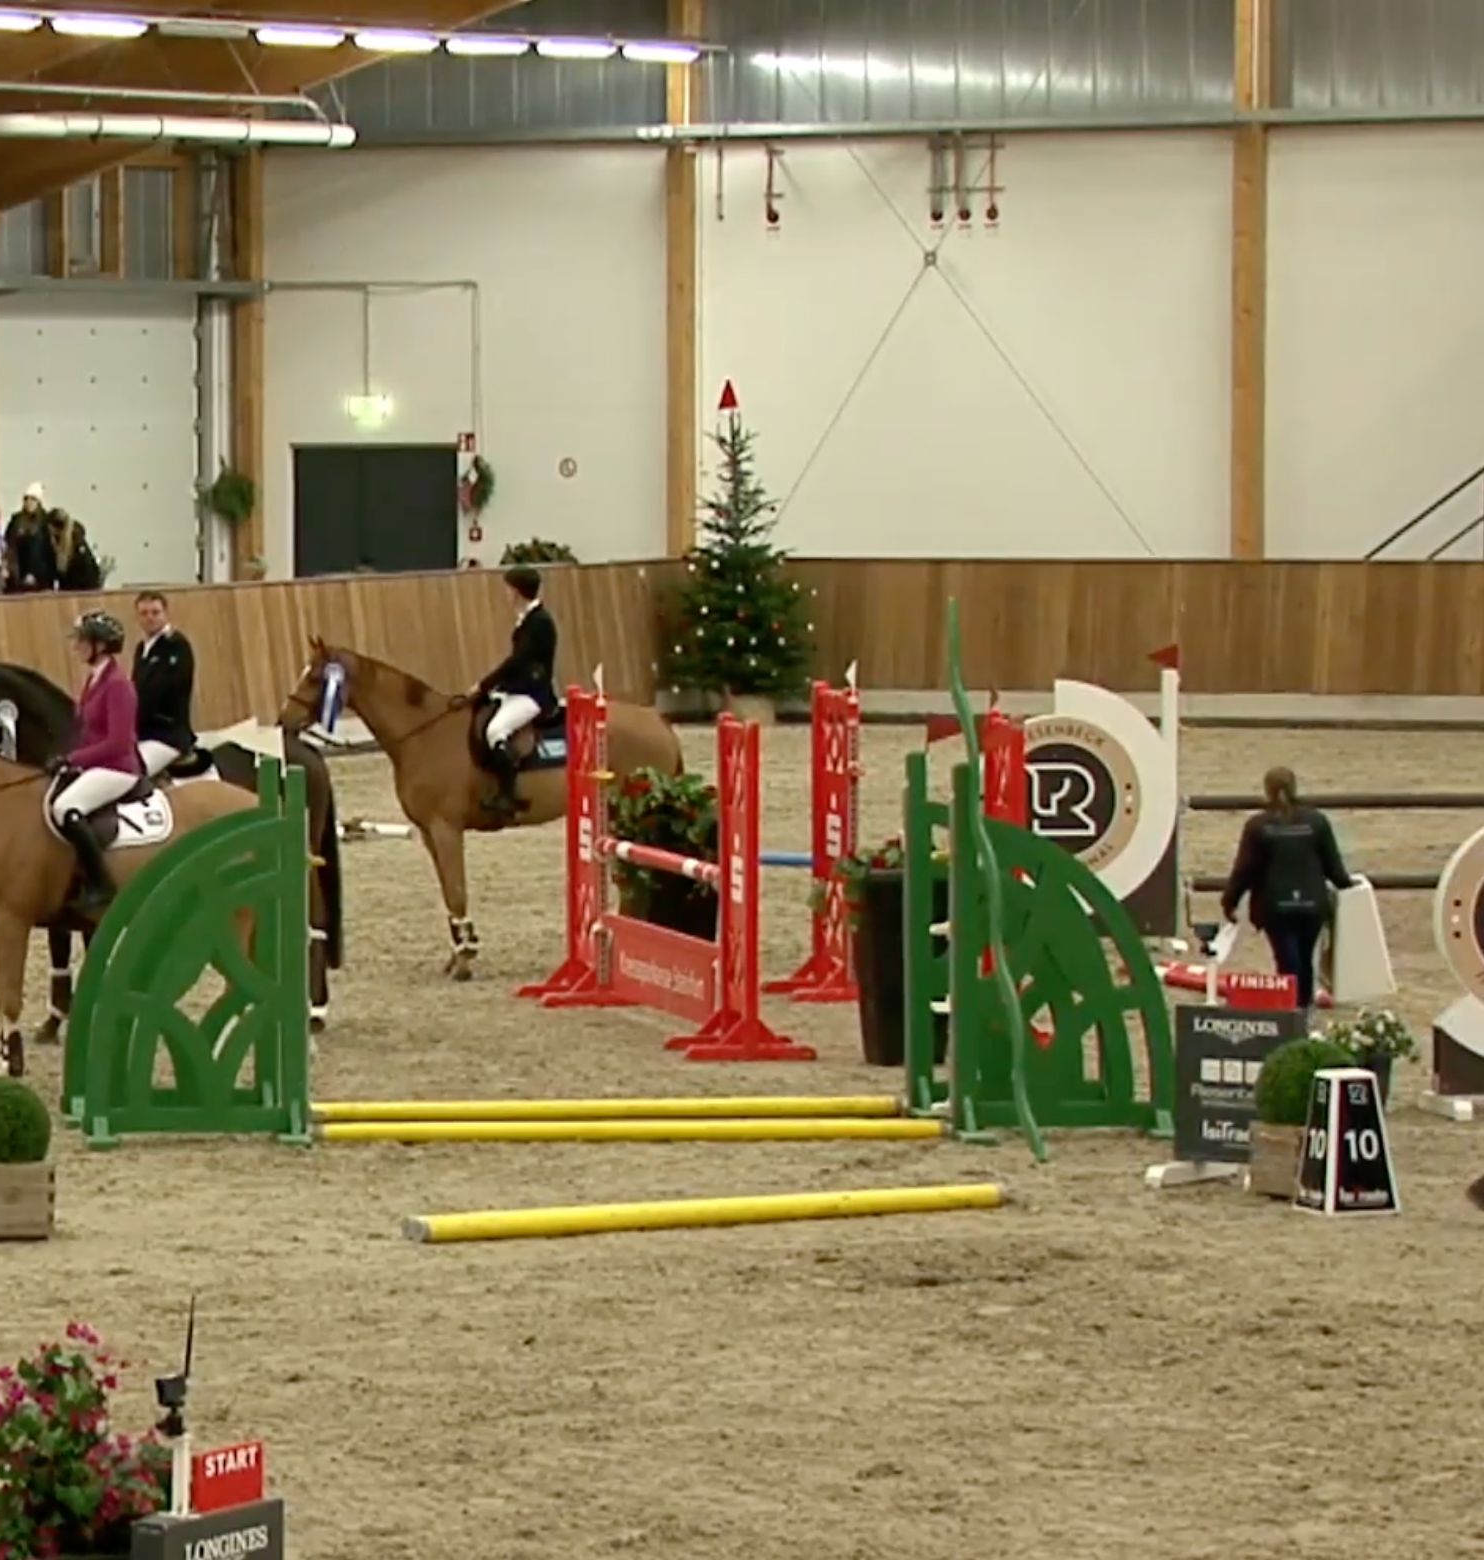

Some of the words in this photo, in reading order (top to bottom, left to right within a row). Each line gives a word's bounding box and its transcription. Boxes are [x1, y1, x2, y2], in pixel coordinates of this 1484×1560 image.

[1229, 973, 1290, 991] FINISH
[1192, 1017, 1280, 1037] LONGINES
[1308, 1128, 1327, 1160] 10
[1343, 1128, 1380, 1162] 10
[204, 1445, 259, 1478] START
[184, 1525, 269, 1560] LONGINES
